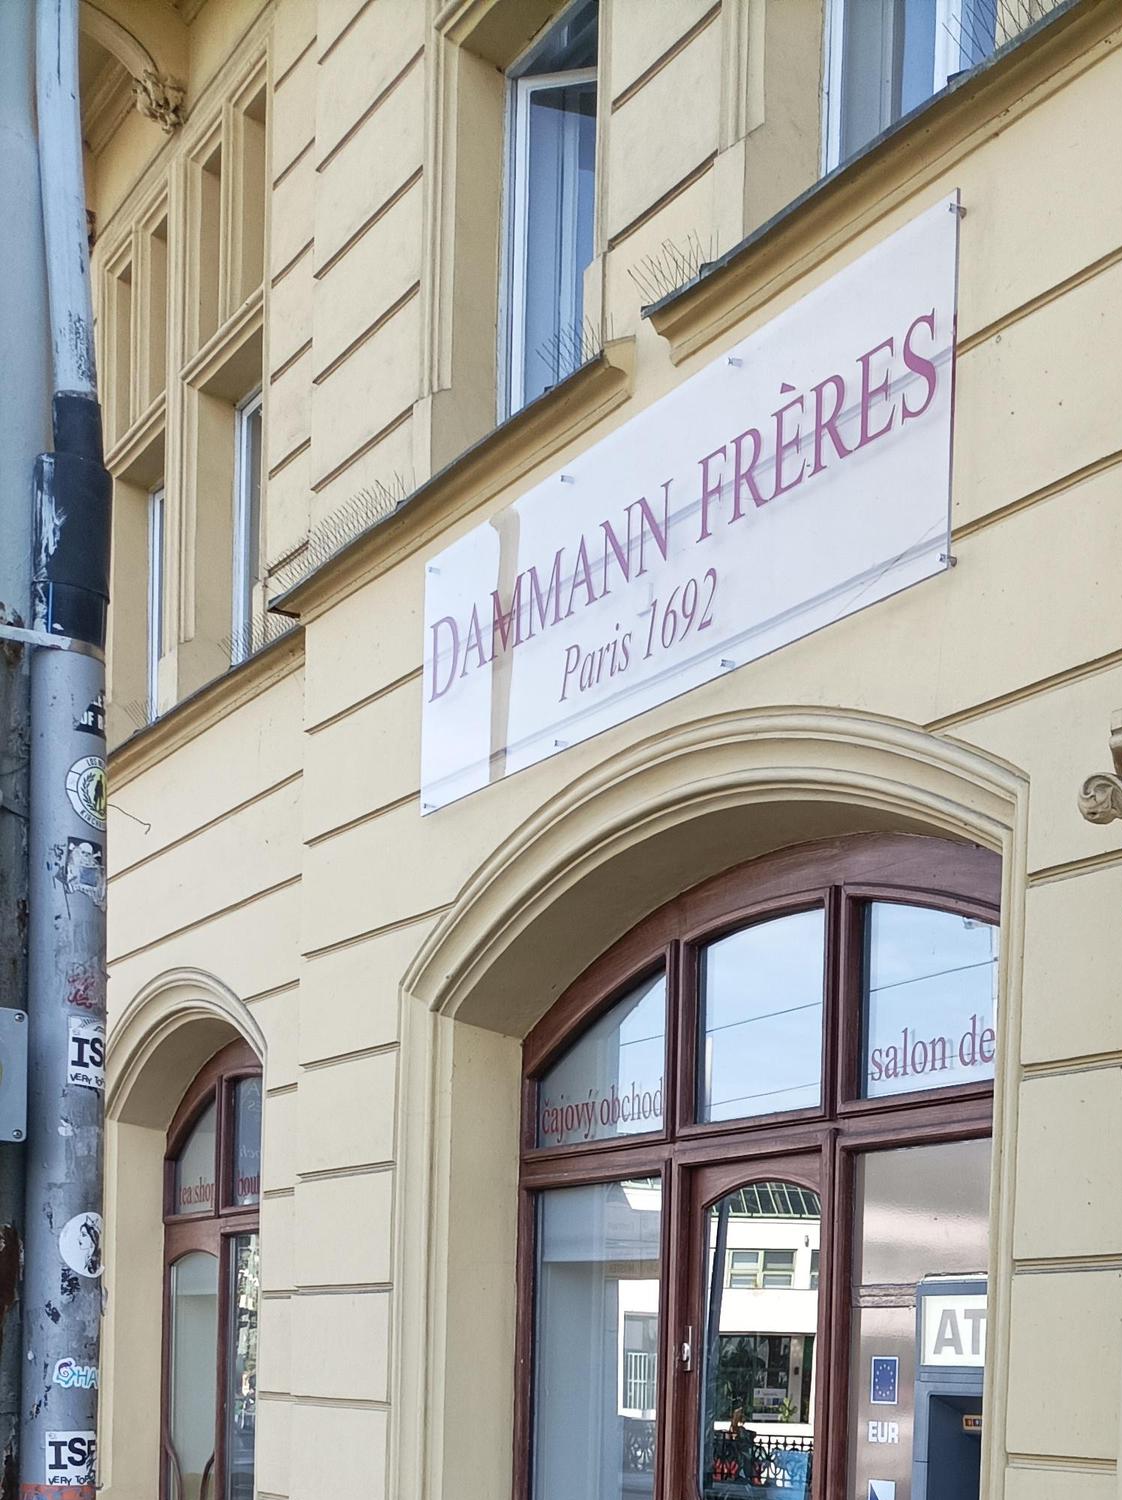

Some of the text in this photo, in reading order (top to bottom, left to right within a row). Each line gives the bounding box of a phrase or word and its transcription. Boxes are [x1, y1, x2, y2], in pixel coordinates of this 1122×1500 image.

[428, 307, 937, 703] DAMMANN FRÈRES
[559, 567, 718, 703] Paris 1692
[870, 1013, 995, 1082] salon de
[70, 1072, 92, 1085] VERY
[541, 1077, 663, 1144] čajový obchod
[179, 1182, 193, 1207] tea
[868, 1421, 899, 1444] EUR
[48, 1475, 72, 1487] VERY
